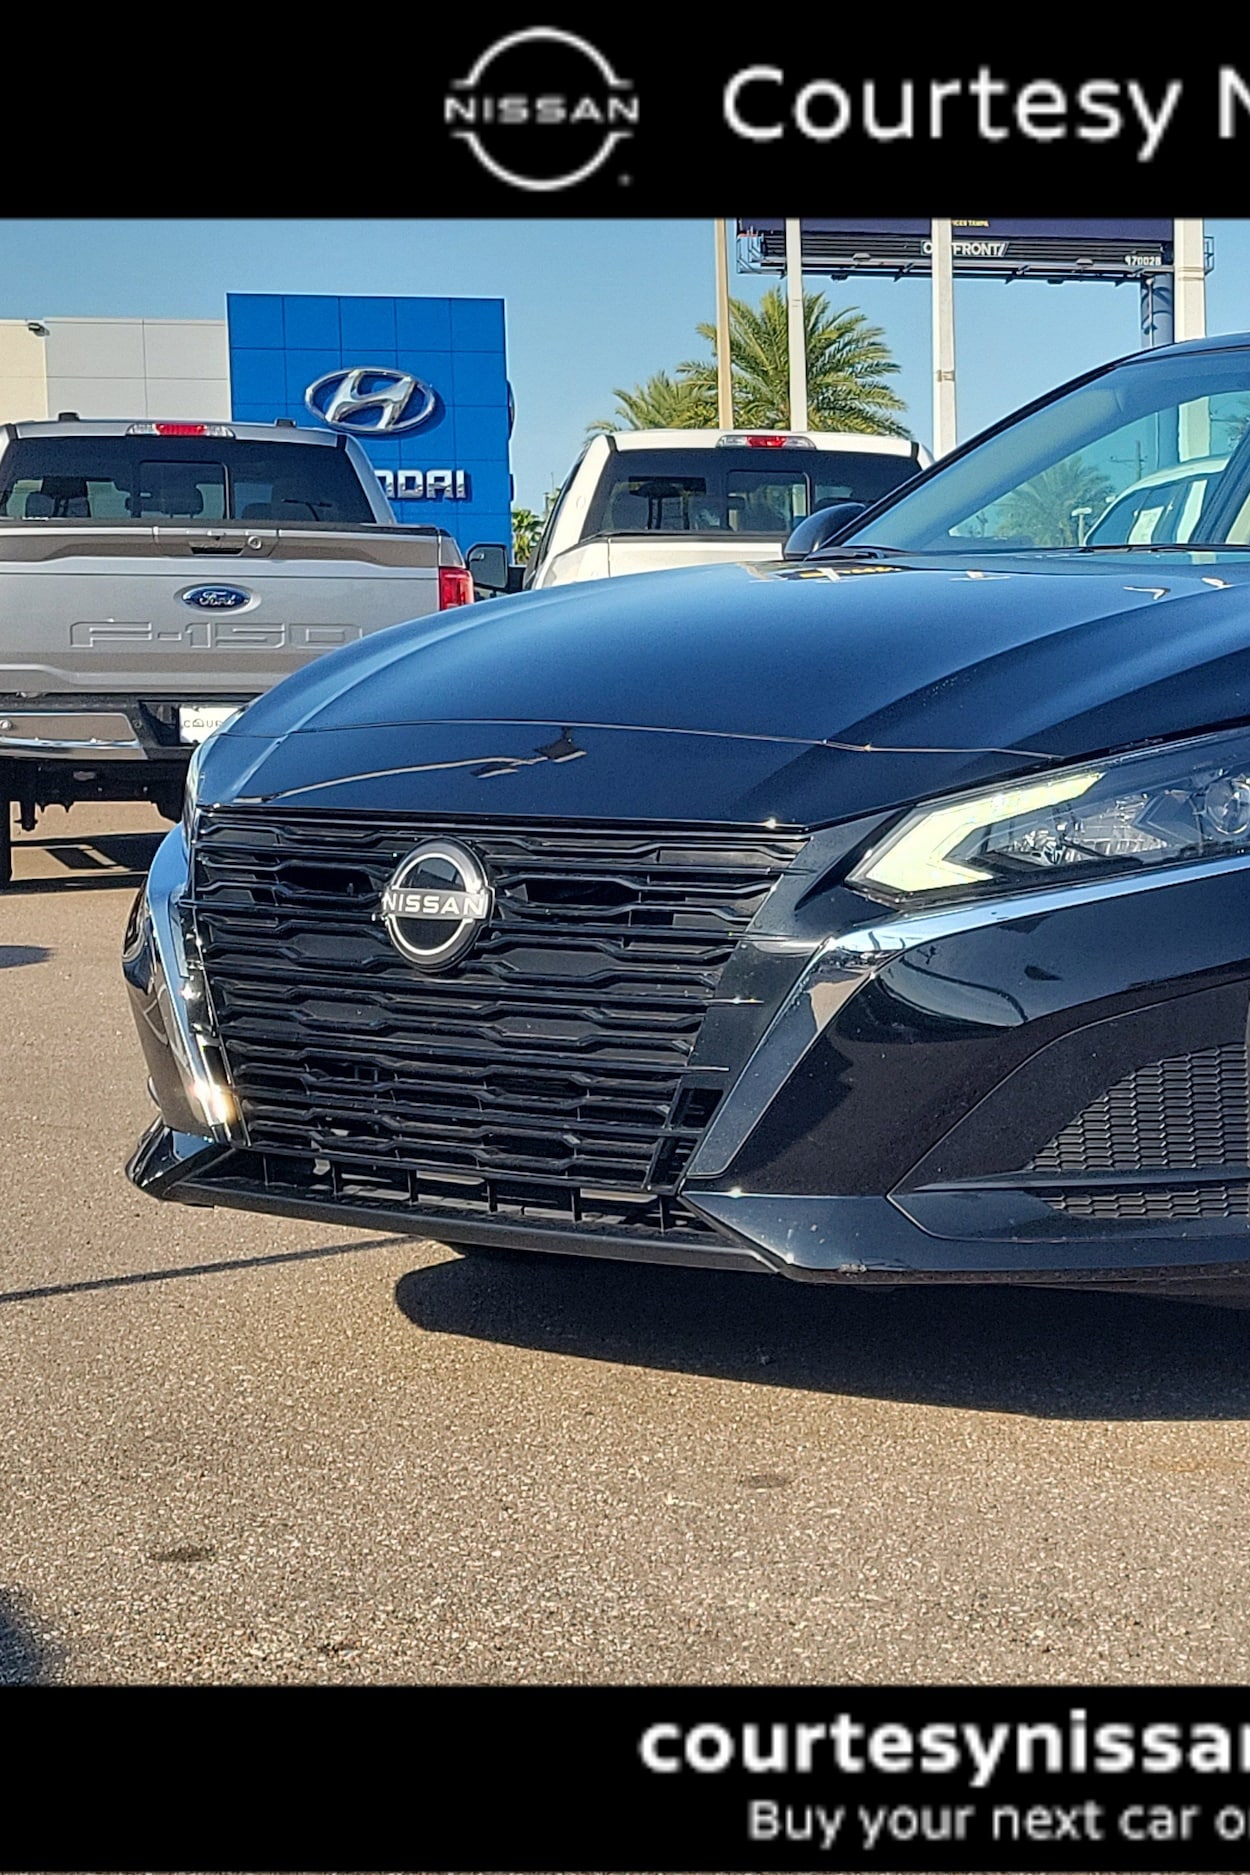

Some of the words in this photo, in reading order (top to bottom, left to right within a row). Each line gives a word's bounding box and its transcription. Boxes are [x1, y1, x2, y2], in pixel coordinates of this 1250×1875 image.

[923, 241, 1009, 257] OFRONT/
[374, 469, 466, 499] NDAI
[199, 590, 236, 606] Ford
[70, 621, 363, 649] F-150
[381, 890, 486, 917] NISSAN
